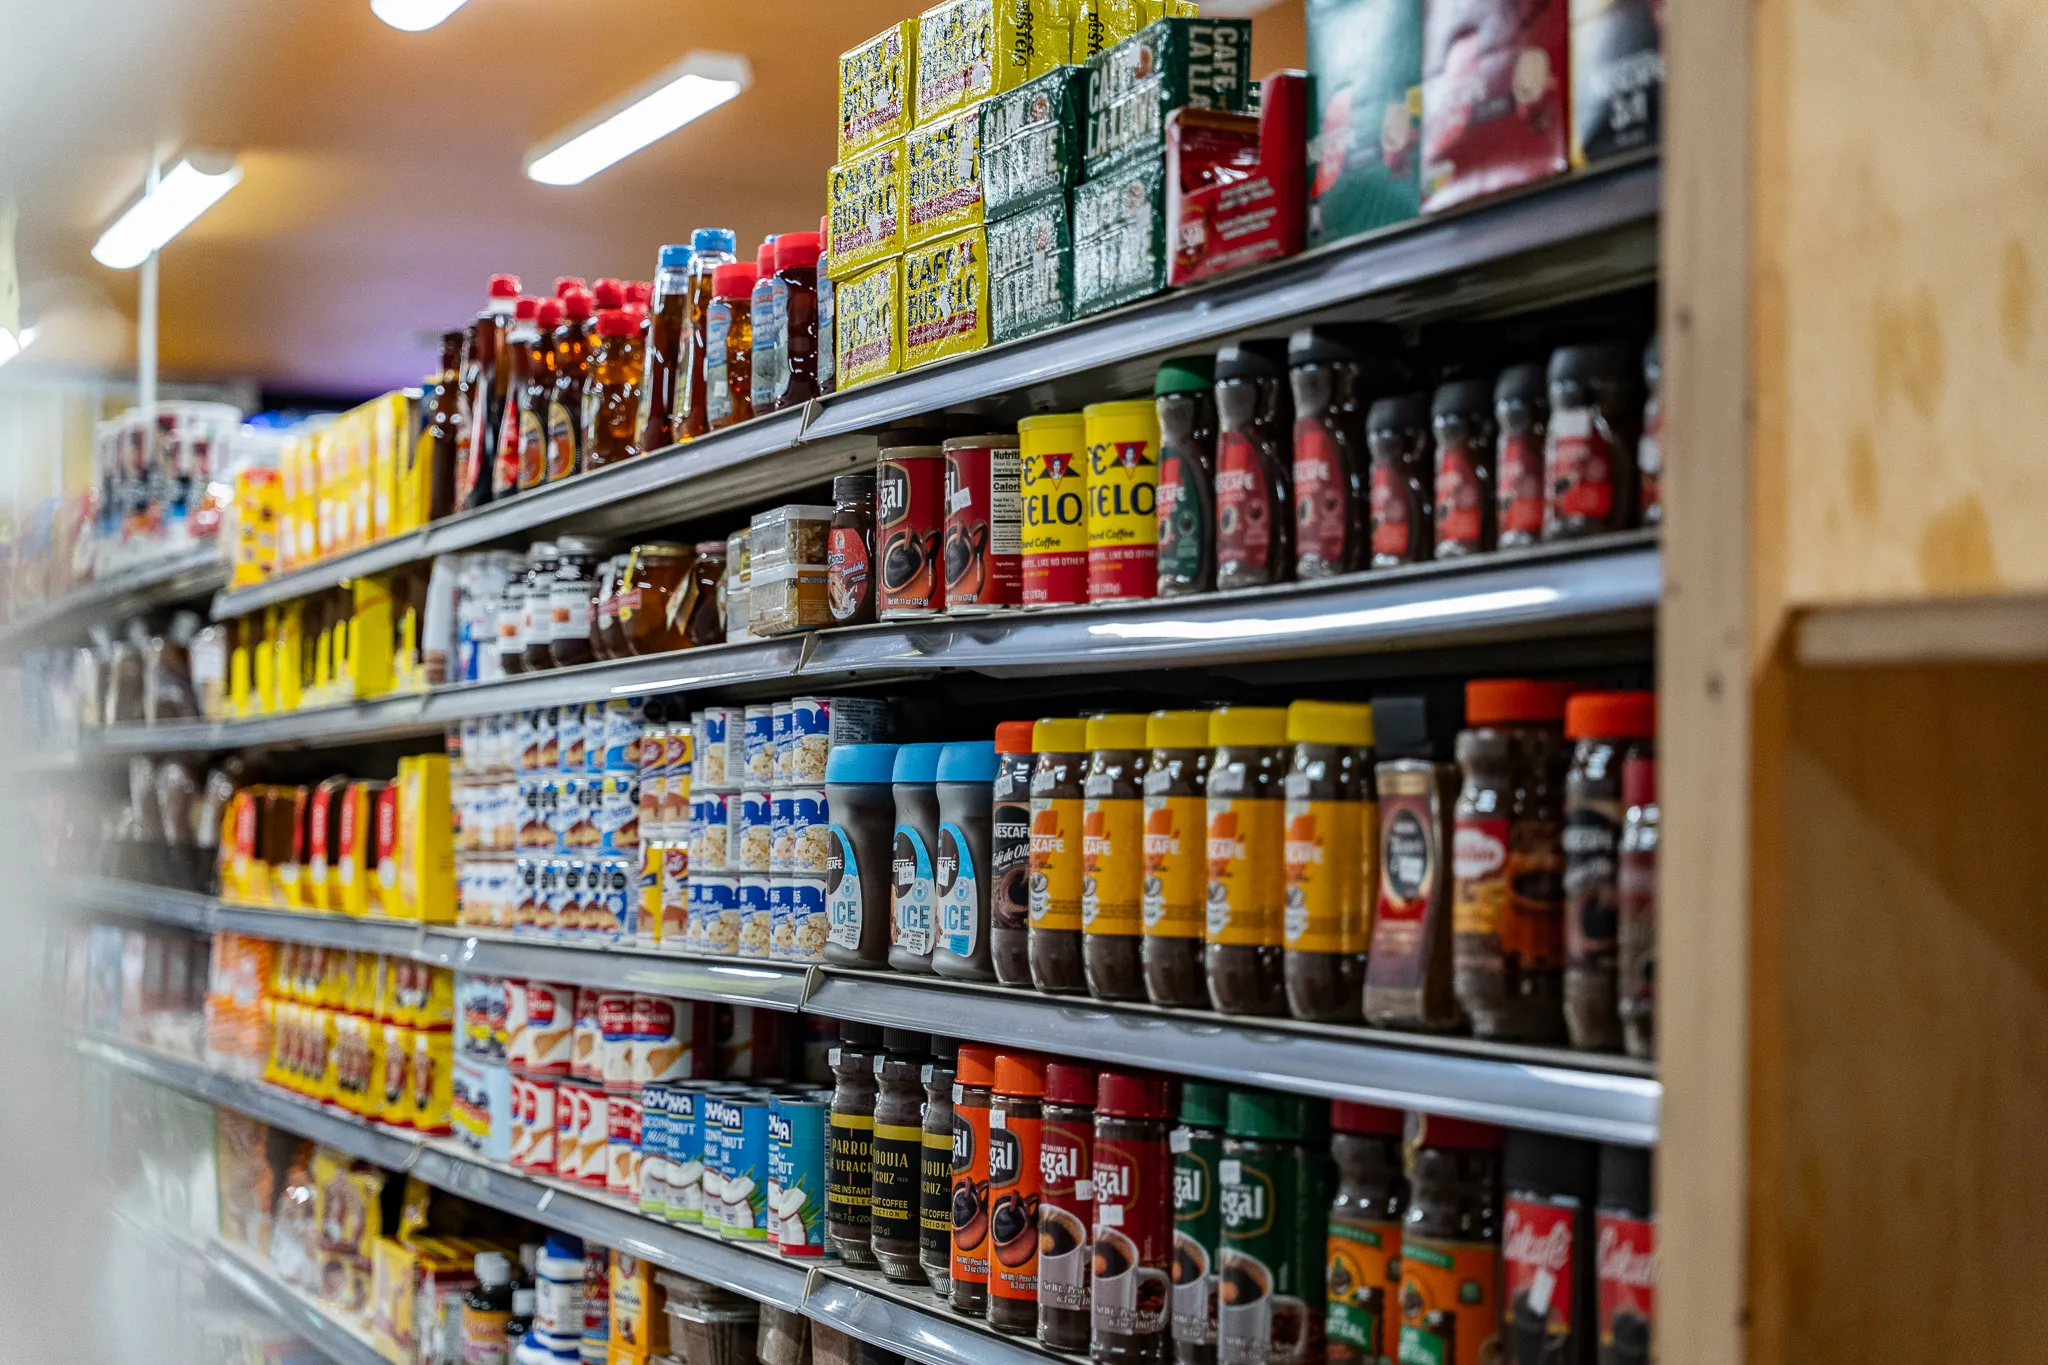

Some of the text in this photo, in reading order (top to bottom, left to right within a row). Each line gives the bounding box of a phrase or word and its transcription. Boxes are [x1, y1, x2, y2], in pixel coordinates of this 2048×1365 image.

[881, 479, 903, 519] gal
[1105, 530, 1135, 542] Coffee
[1035, 537, 1061, 549] Coffee
[1050, 557, 1060, 567] NO
[1061, 556, 1085, 567] OTHER
[832, 901, 857, 924] ICE
[902, 904, 930, 930] ICE
[944, 904, 971, 931] ICE
[990, 1142, 1013, 1177] gal
[1040, 1147, 1077, 1184] egal
[1093, 1165, 1129, 1204] egal
[1174, 1169, 1201, 1209] gal
[842, 1185, 872, 1197] INSTANT
[882, 1197, 908, 1209] COFFEE
[847, 1214, 855, 1222] oz
[883, 1226, 891, 1236] g)
[930, 1239, 937, 1248] g)
[970, 1258, 982, 1268] Peso
[963, 1265, 971, 1273] 6.3
[971, 1266, 976, 1274] oz
[1010, 1281, 1019, 1290] 6.3
[1018, 1275, 1032, 1284] Peso
